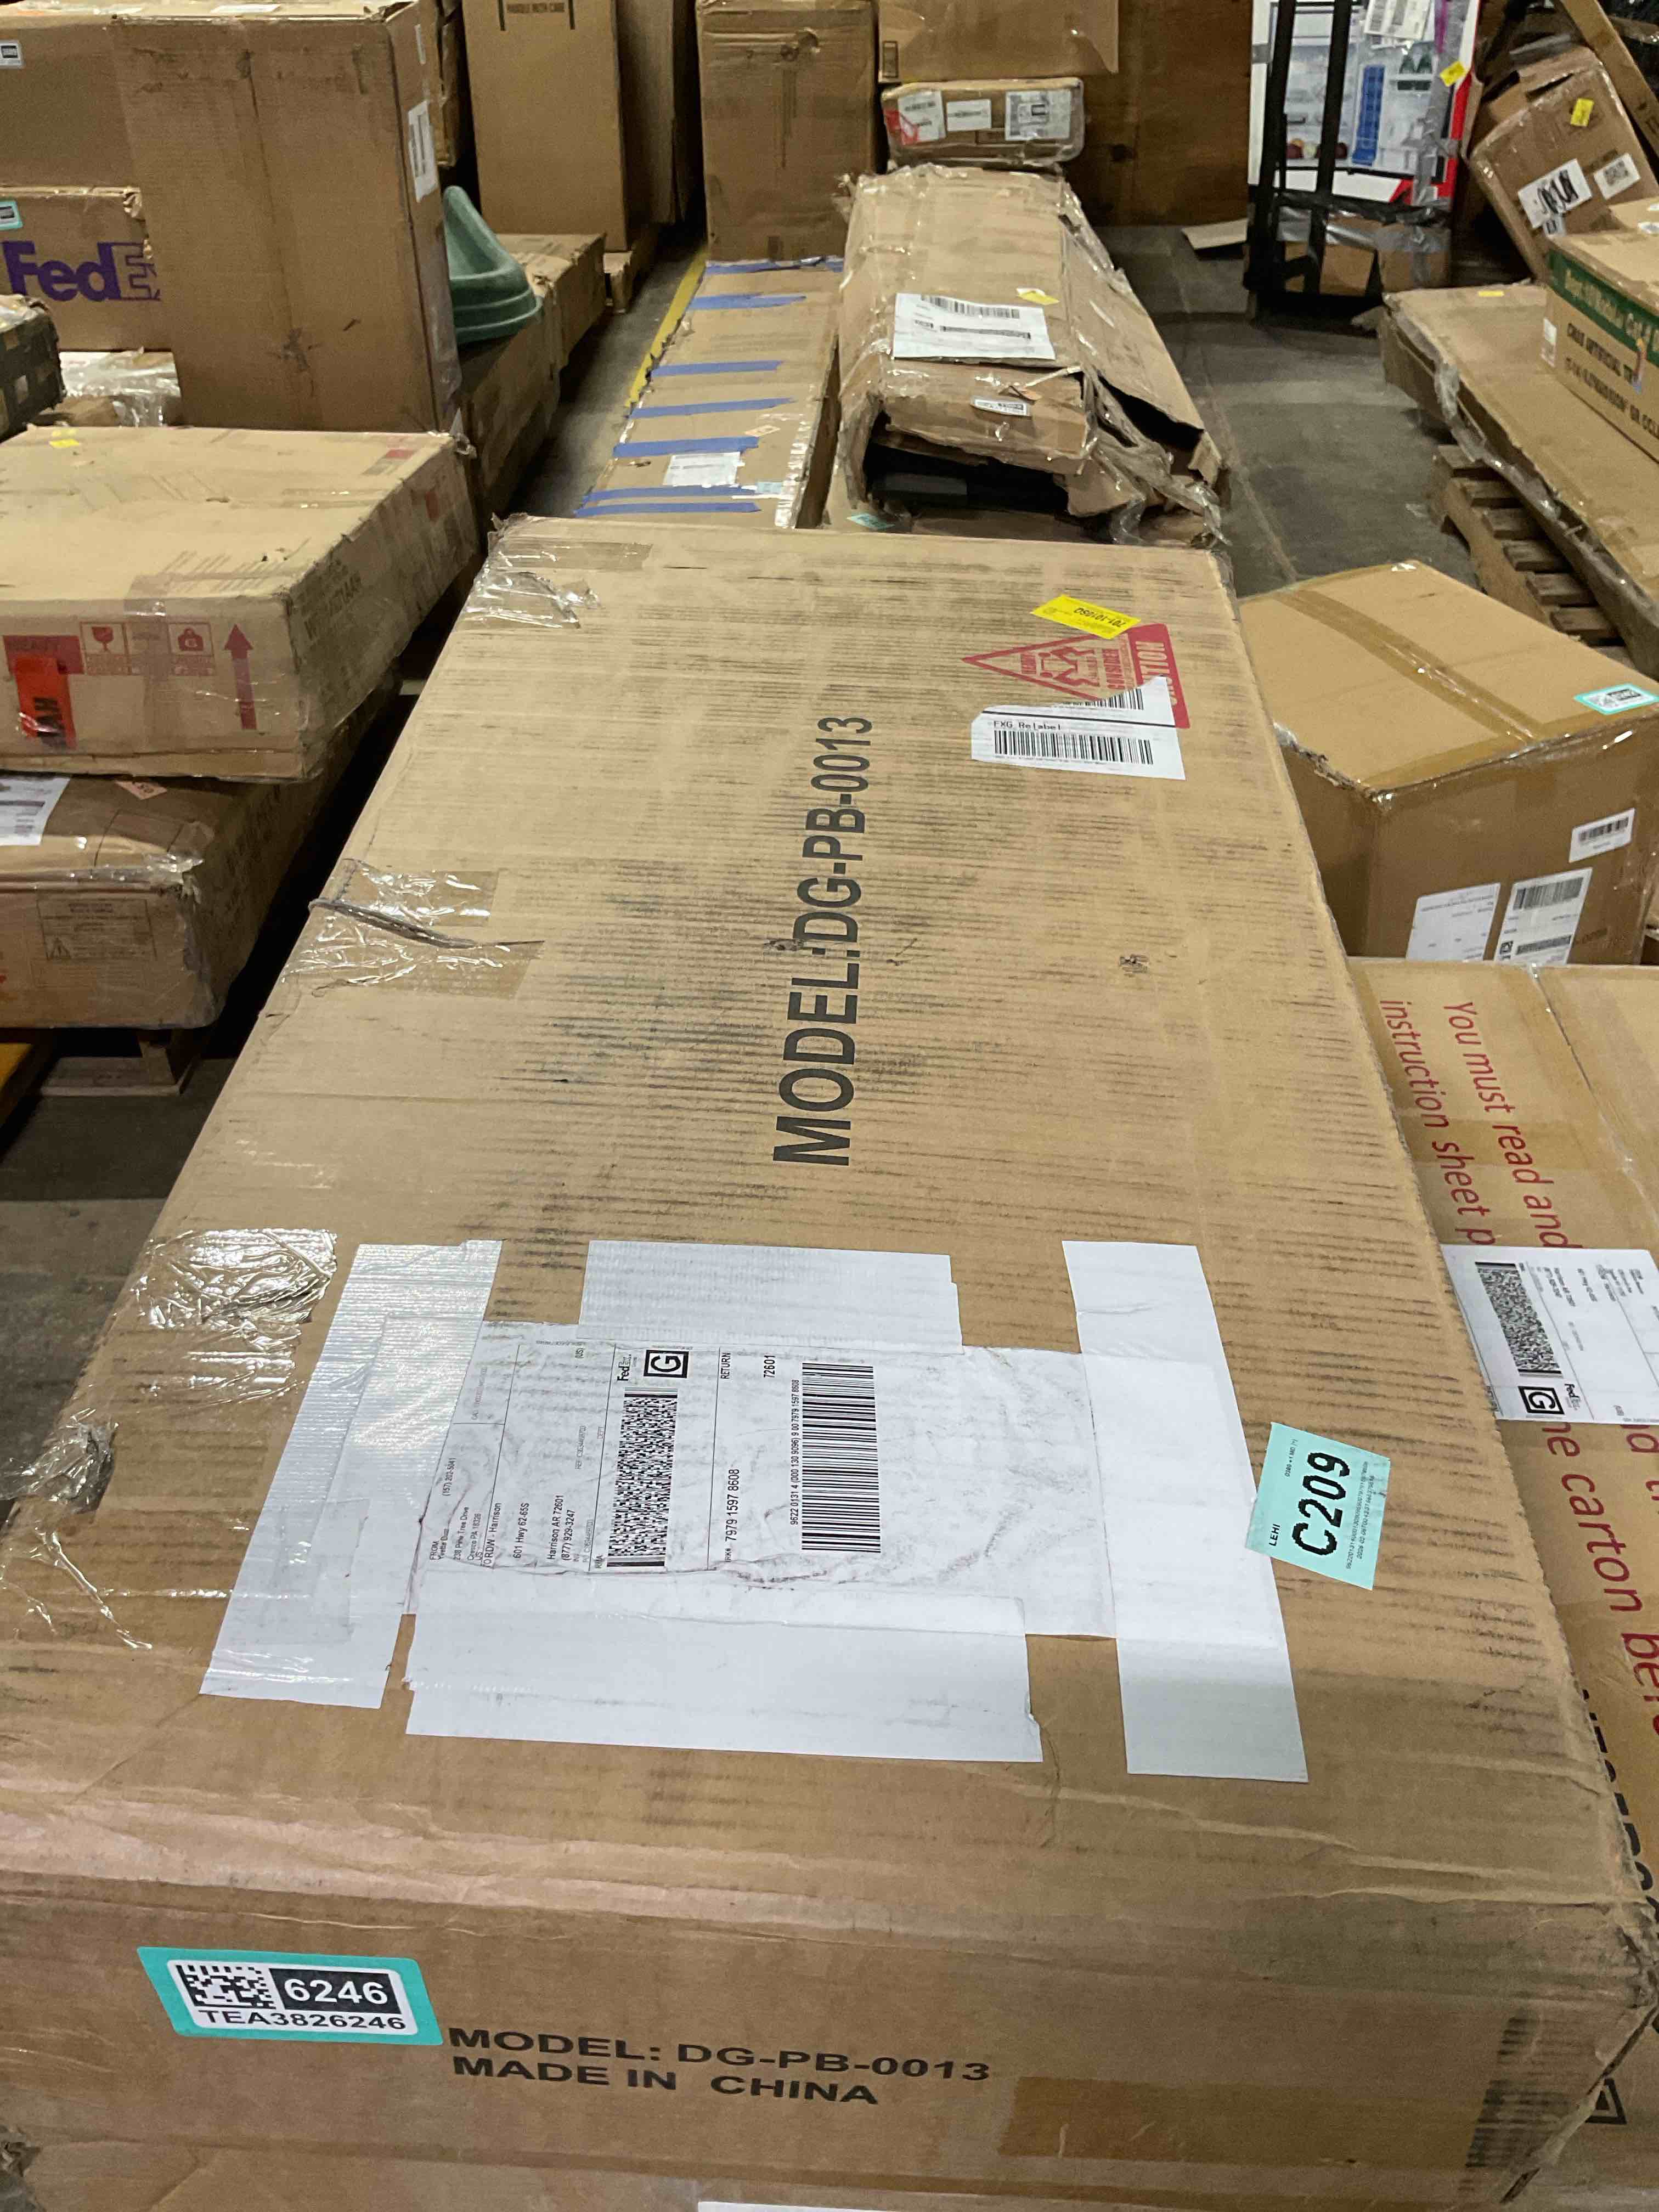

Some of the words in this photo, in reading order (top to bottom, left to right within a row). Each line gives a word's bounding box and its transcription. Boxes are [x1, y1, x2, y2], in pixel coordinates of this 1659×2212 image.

[1019, 721, 1061, 730] Relabel
[1380, 1000, 1449, 1128] instruction
[1431, 1140, 1491, 1216] sheet
[1443, 1002, 1481, 1045] You
[1463, 1053, 1515, 1113] must
[1492, 1125, 1554, 1184] read
[1523, 1194, 1583, 1249] and
[651, 1356, 681, 1372] G
[720, 1352, 731, 1379] RETURN
[764, 1355, 776, 1378] 72601
[1528, 1391, 1556, 1409] G
[791, 1438, 801, 1454] 9096)
[727, 1469, 740, 1491] 8608
[791, 1469, 800, 1483] (000
[554, 1495, 564, 1516] 72601
[726, 1494, 738, 1516] 1597
[791, 1491, 799, 1507] 0131
[1292, 1452, 1350, 1556] C209
[489, 1503, 502, 1533] Harrison
[518, 1503, 529, 1526] 62-65S
[552, 1516, 561, 1528] AR
[563, 1509, 575, 1542] 929-3247
[790, 1508, 798, 1525] 9622
[471, 1533, 477, 1542] PA
[516, 1527, 525, 1543] Hwy
[725, 1519, 737, 1542] 7979
[1269, 1524, 1281, 1546] LEHI
[430, 1541, 439, 1560] FROM
[514, 1545, 522, 1559] 601
[547, 1528, 559, 1560] Harrison
[561, 1542, 569, 1561] (877)
[1561, 1473, 1643, 1612] carton
[284, 1978, 388, 2005] 6246
[198, 2009, 407, 2030] TEA3826246
[448, 2027, 661, 2062] MODEL:
[677, 2043, 990, 2081] DG-PB-0013
[452, 2055, 610, 2085] MADE
[628, 2069, 676, 2090] IN
[710, 2075, 878, 2105] CHINA
